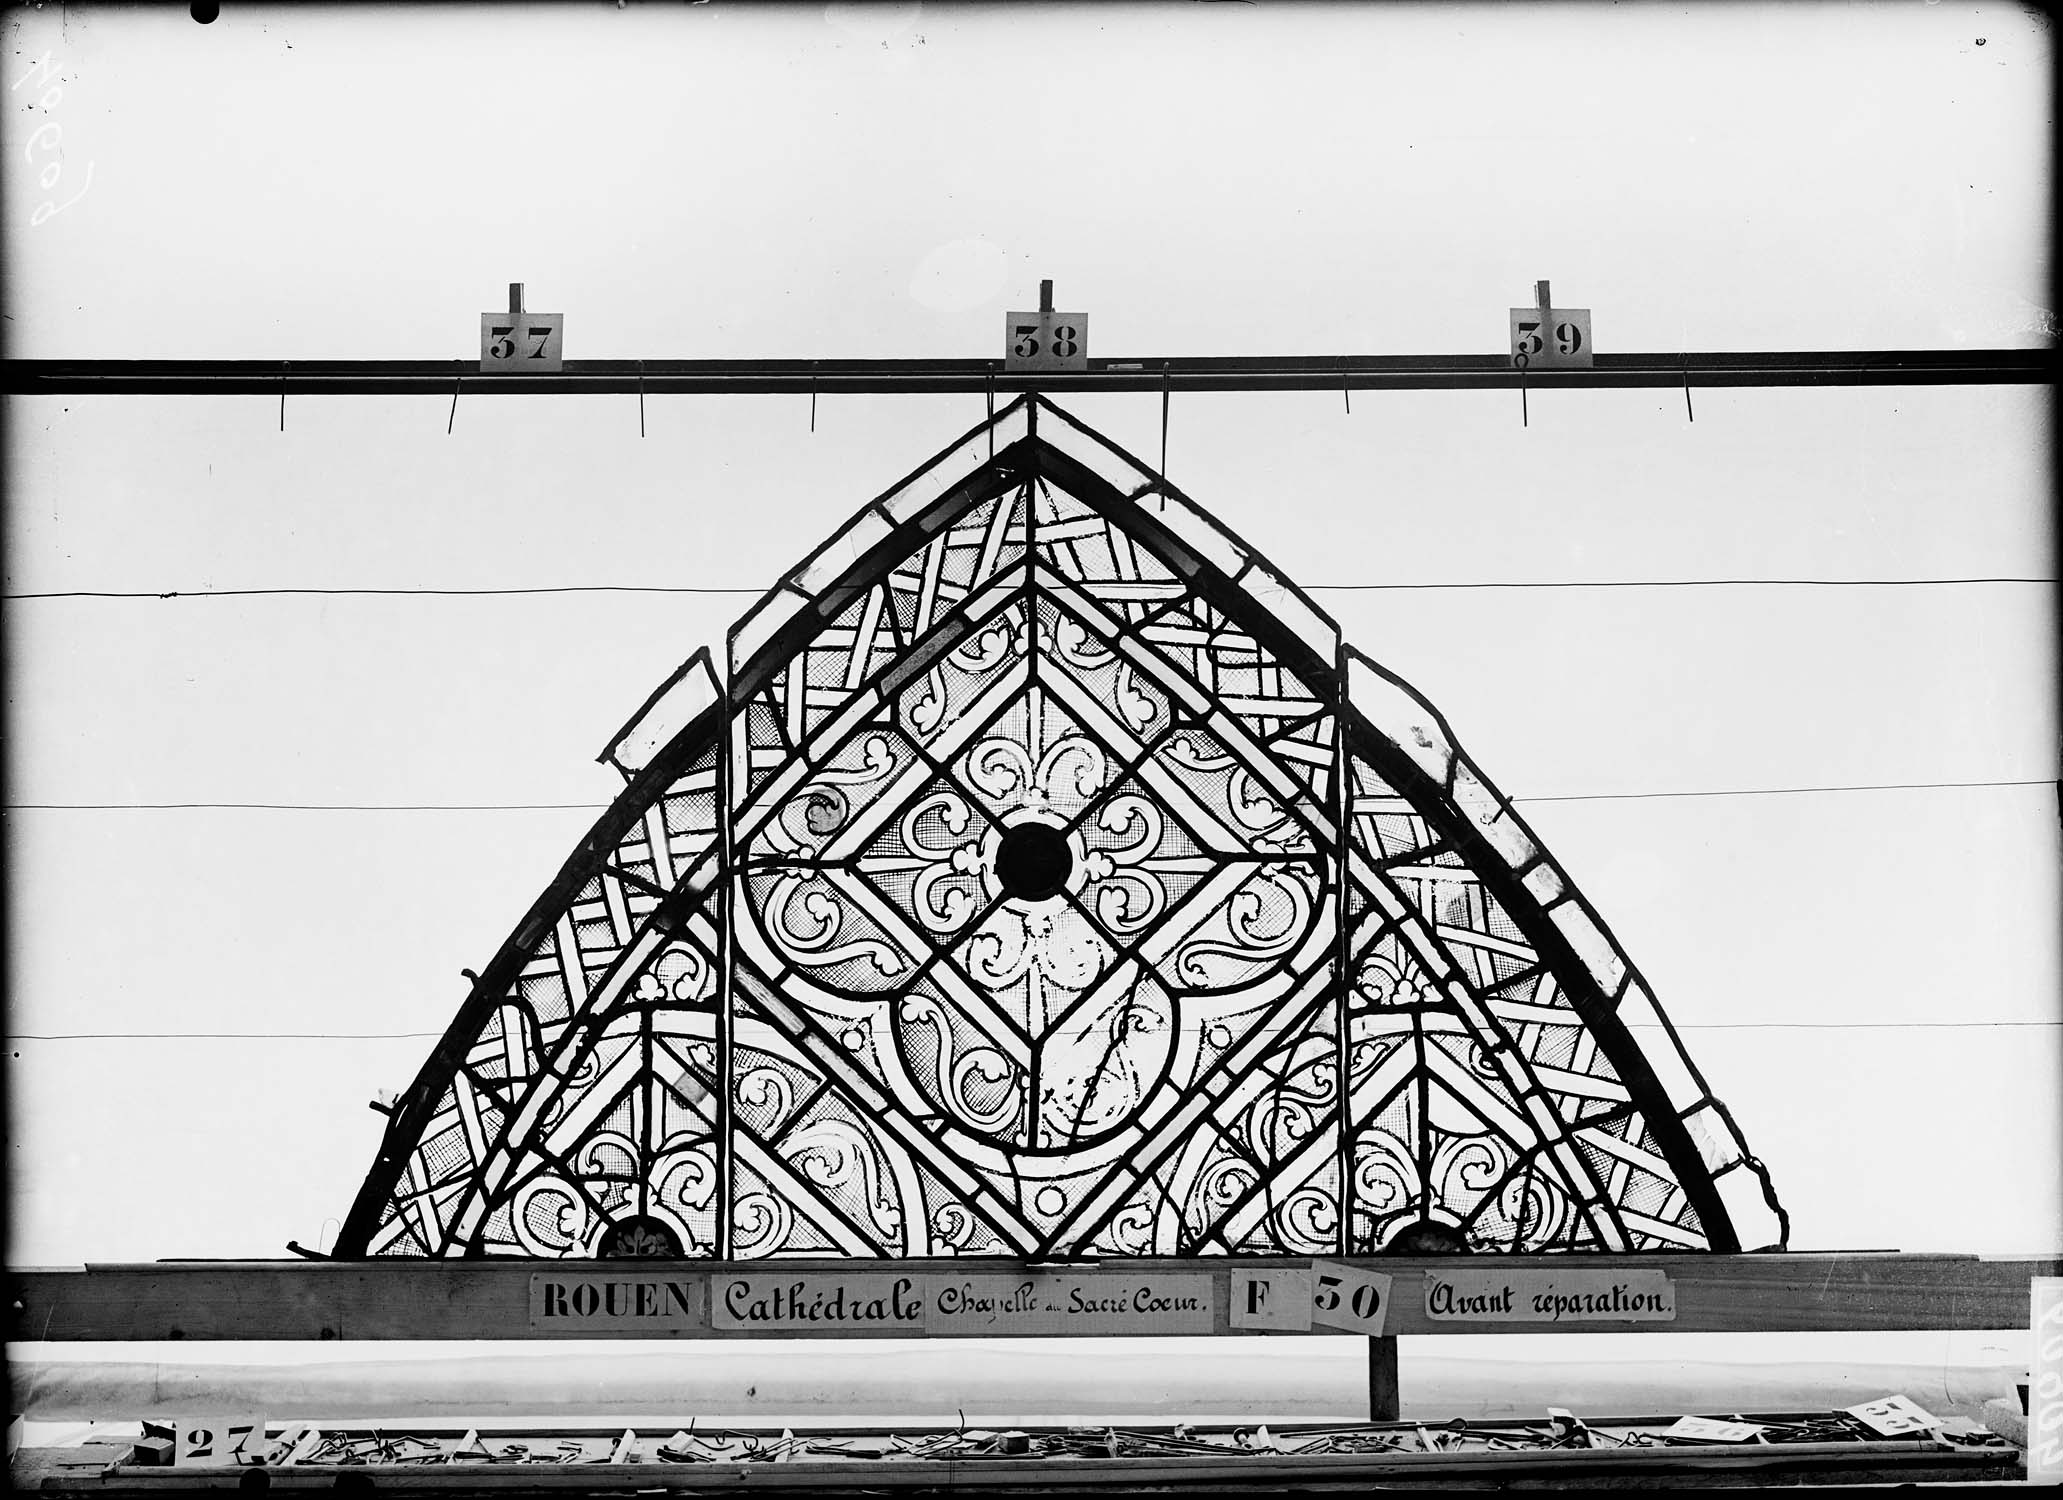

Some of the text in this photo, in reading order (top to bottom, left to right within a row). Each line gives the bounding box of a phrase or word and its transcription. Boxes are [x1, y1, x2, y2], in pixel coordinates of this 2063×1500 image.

[490, 326, 553, 359] 37
[1014, 325, 1078, 358] 38
[1518, 322, 1582, 356] 39
[544, 1282, 693, 1317] ROUEN
[724, 1278, 922, 1322] Cathédrale
[1068, 1287, 1128, 1314] Sacré
[1245, 1275, 1380, 1320] F 30
[1429, 1280, 1673, 1321] Avant réparation.
[186, 1425, 255, 1458] 27
